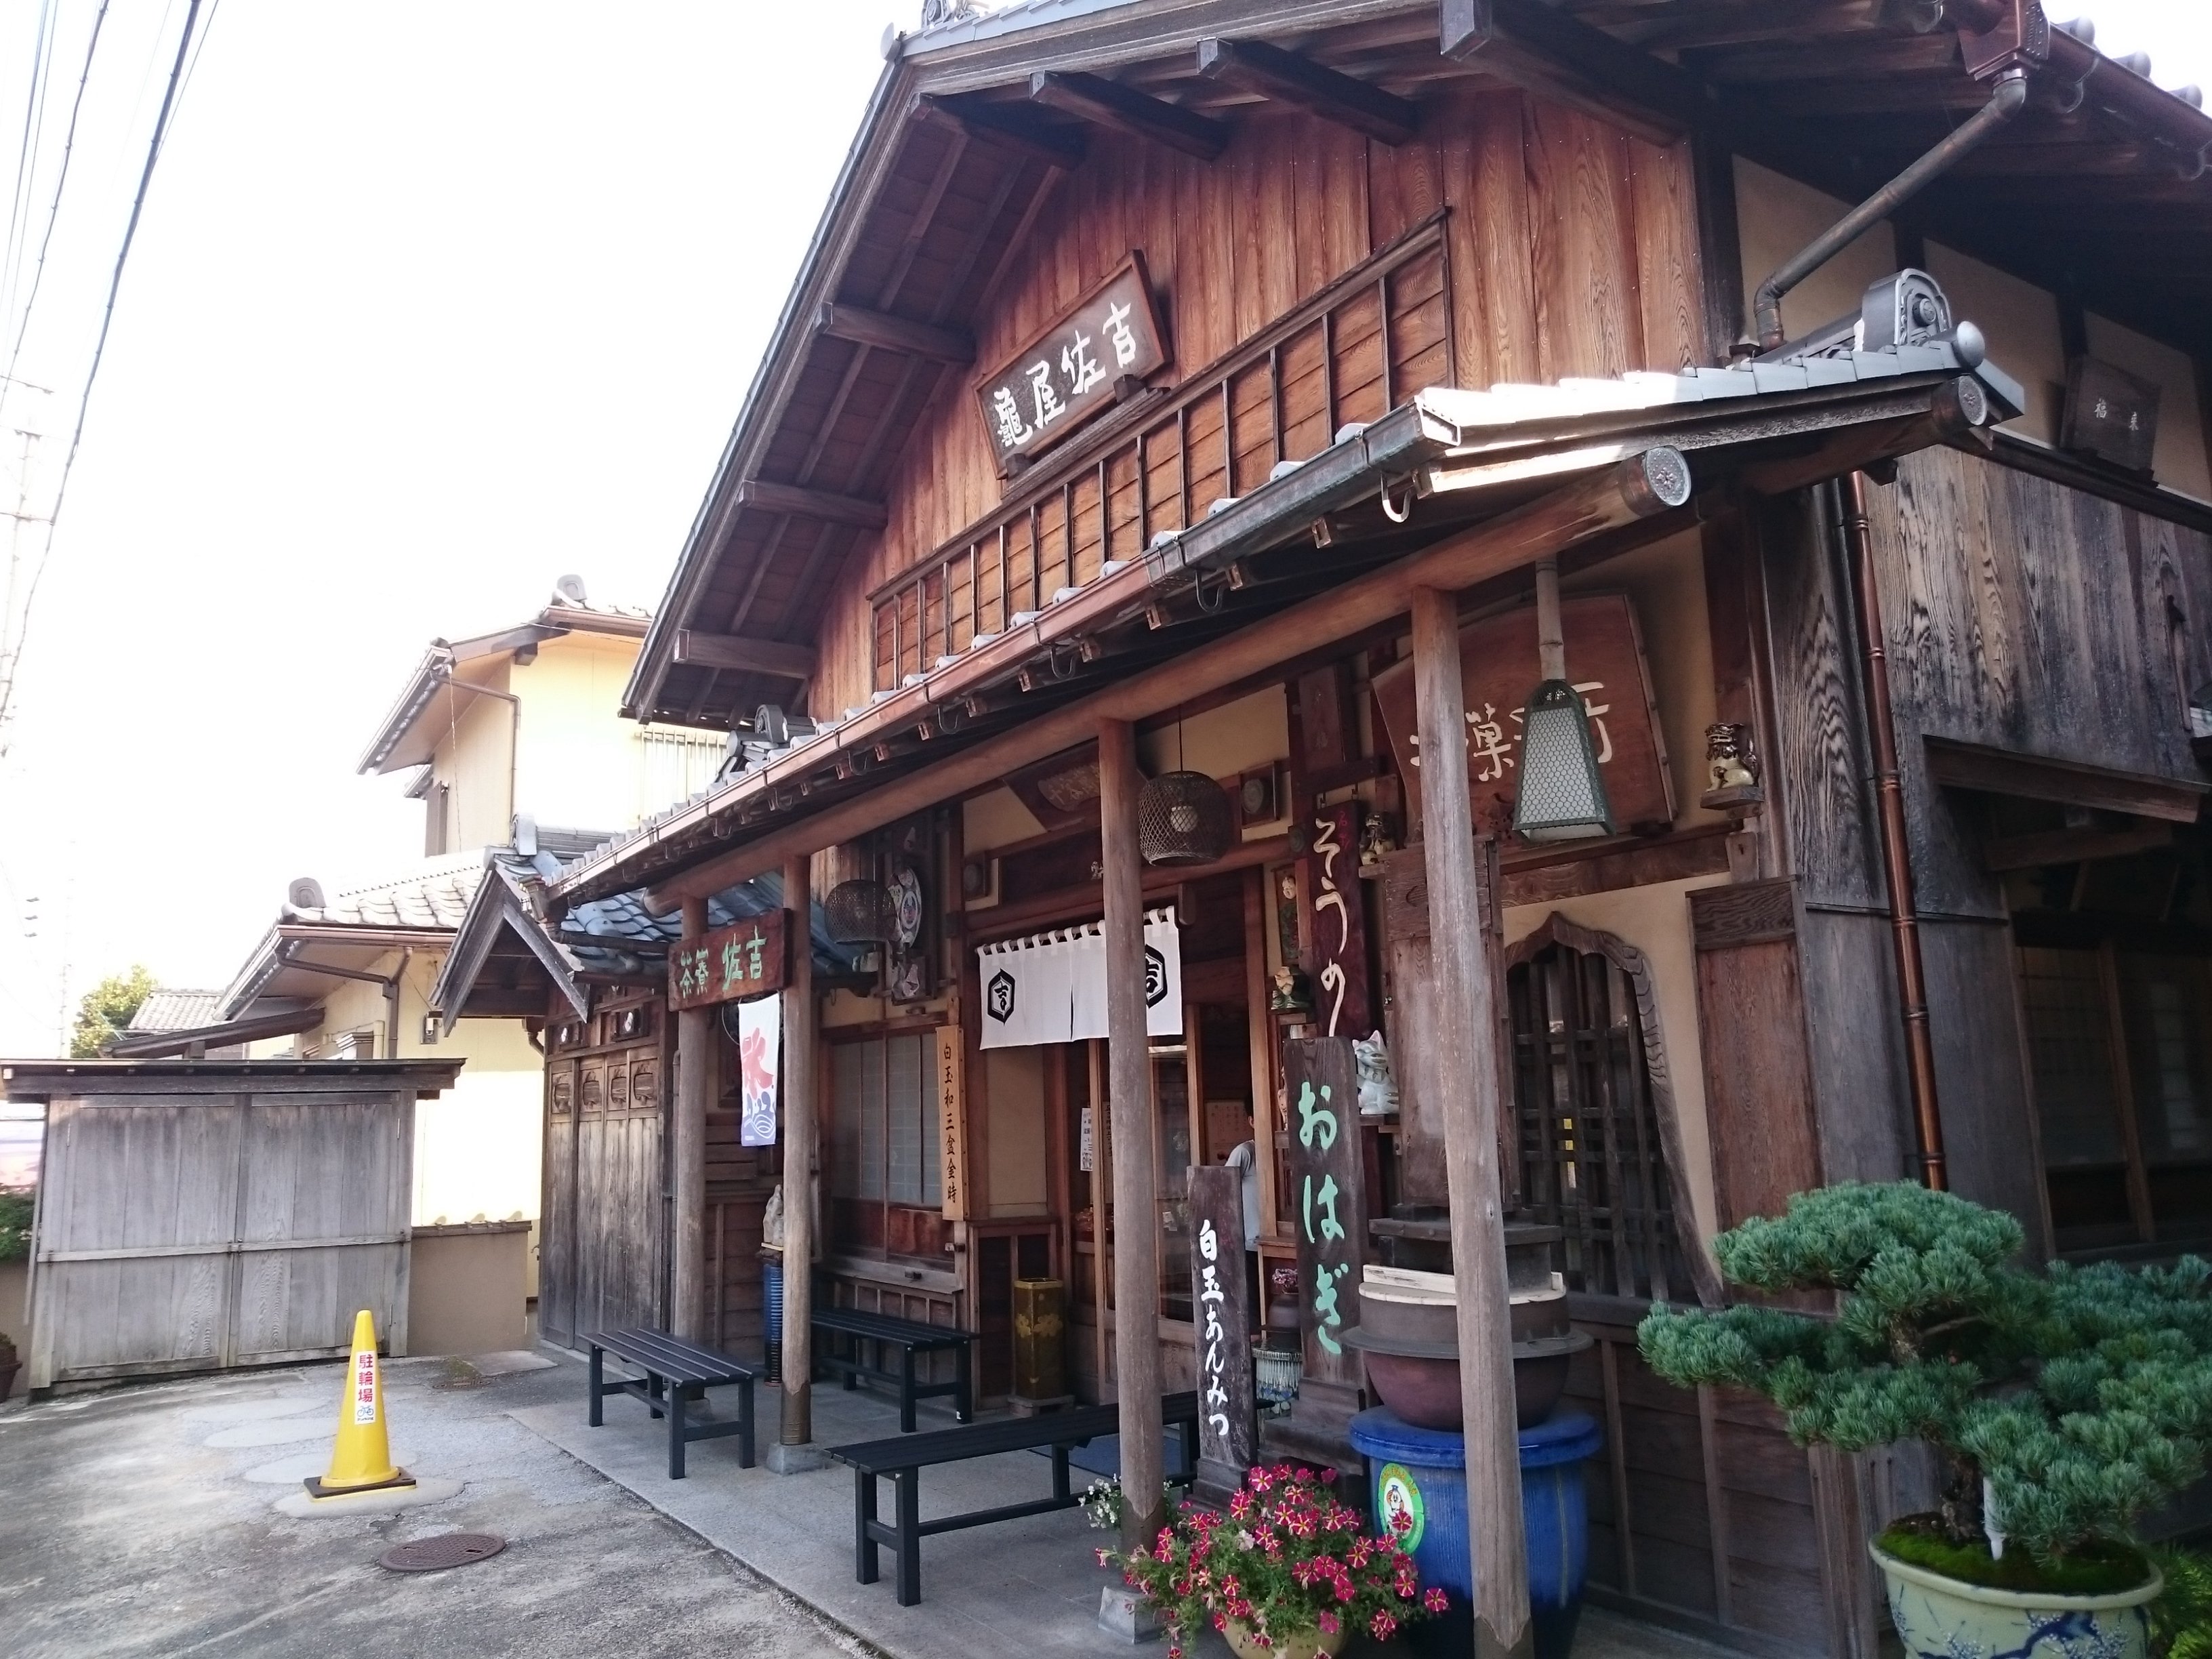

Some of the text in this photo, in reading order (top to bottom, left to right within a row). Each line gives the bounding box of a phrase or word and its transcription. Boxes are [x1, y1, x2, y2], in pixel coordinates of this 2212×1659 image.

[1298, 1081, 1349, 1354] おはぎ
[359, 1354, 373, 1403] 駐輪場
[1199, 1220, 1229, 1436] 白玉あんみつ
